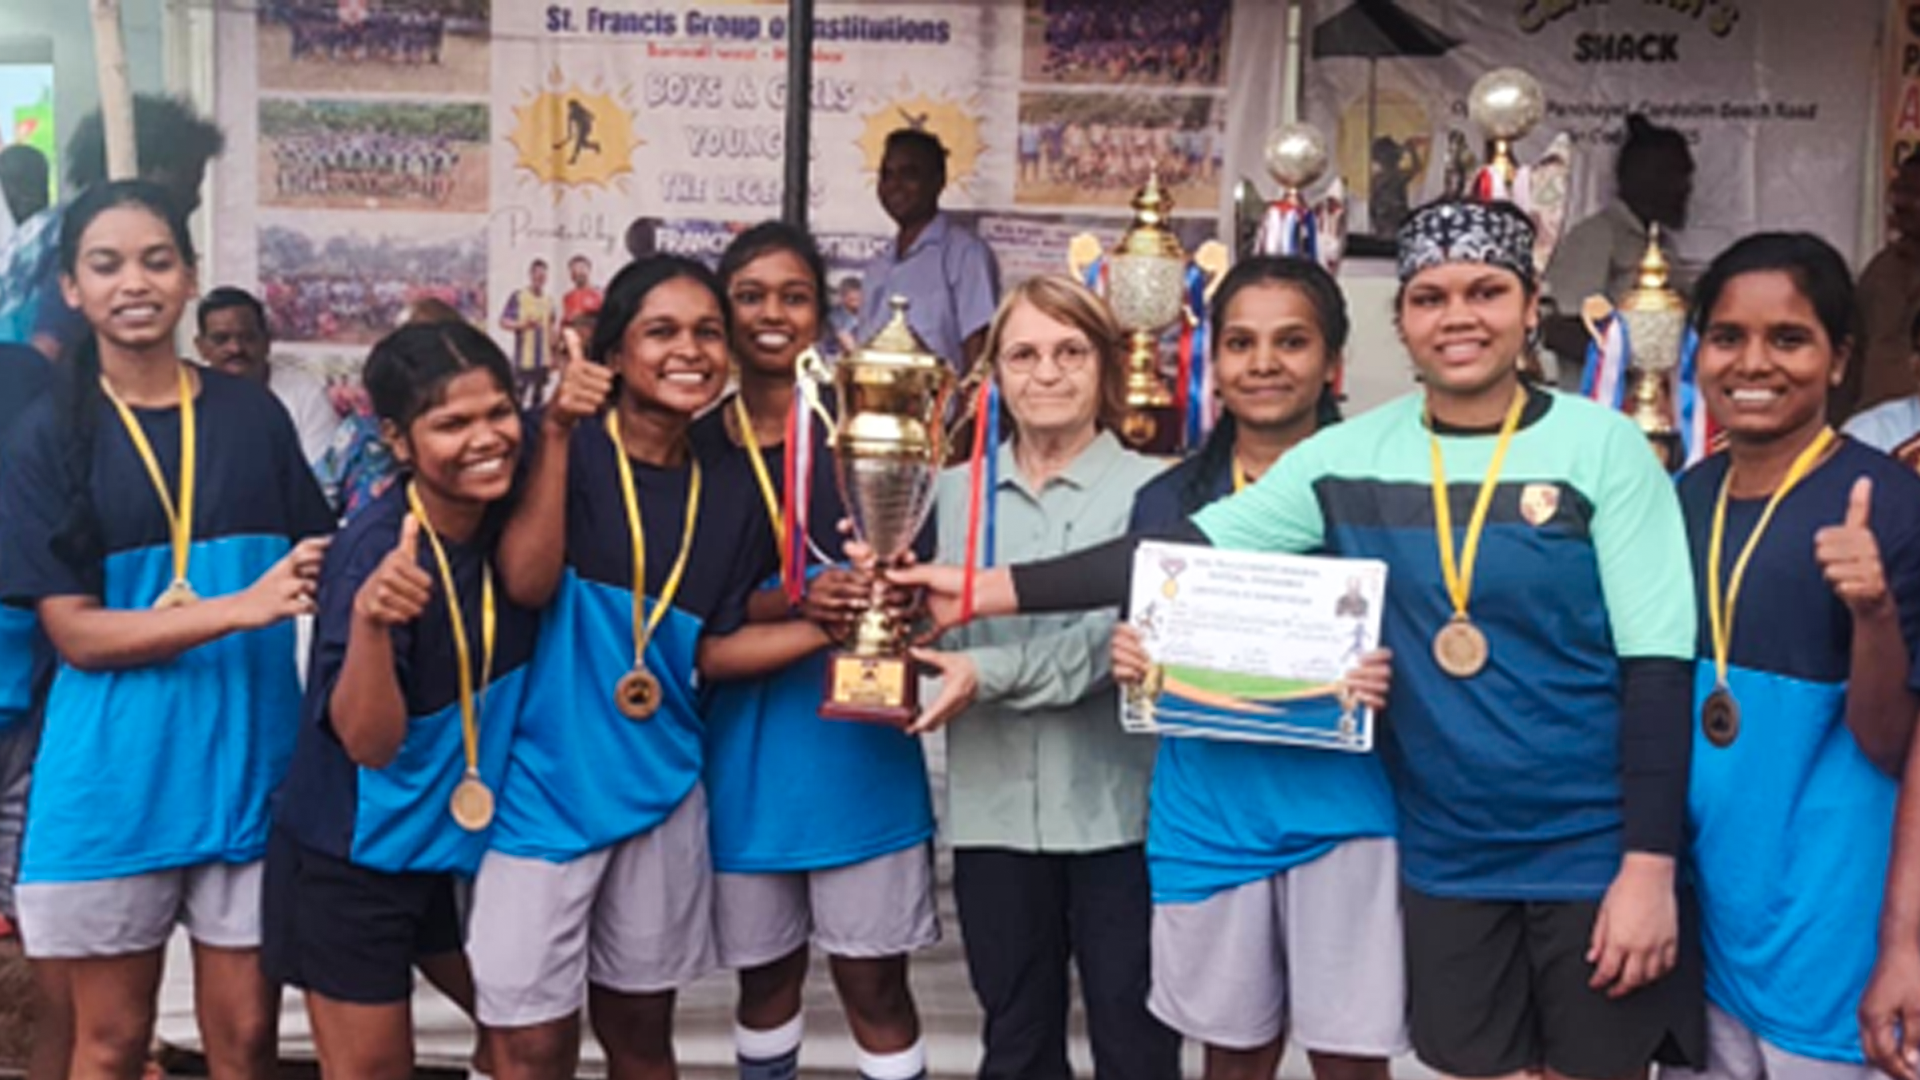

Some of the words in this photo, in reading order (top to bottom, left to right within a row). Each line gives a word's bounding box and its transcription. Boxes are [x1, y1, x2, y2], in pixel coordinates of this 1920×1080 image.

[546, 5, 579, 32] St.
[587, 7, 677, 36] Francis
[685, 10, 761, 40] Group
[812, 14, 950, 44] nstitutions
[1574, 32, 1679, 63] SHACK
[646, 72, 722, 109] BOYS
[766, 76, 854, 113] GLS
